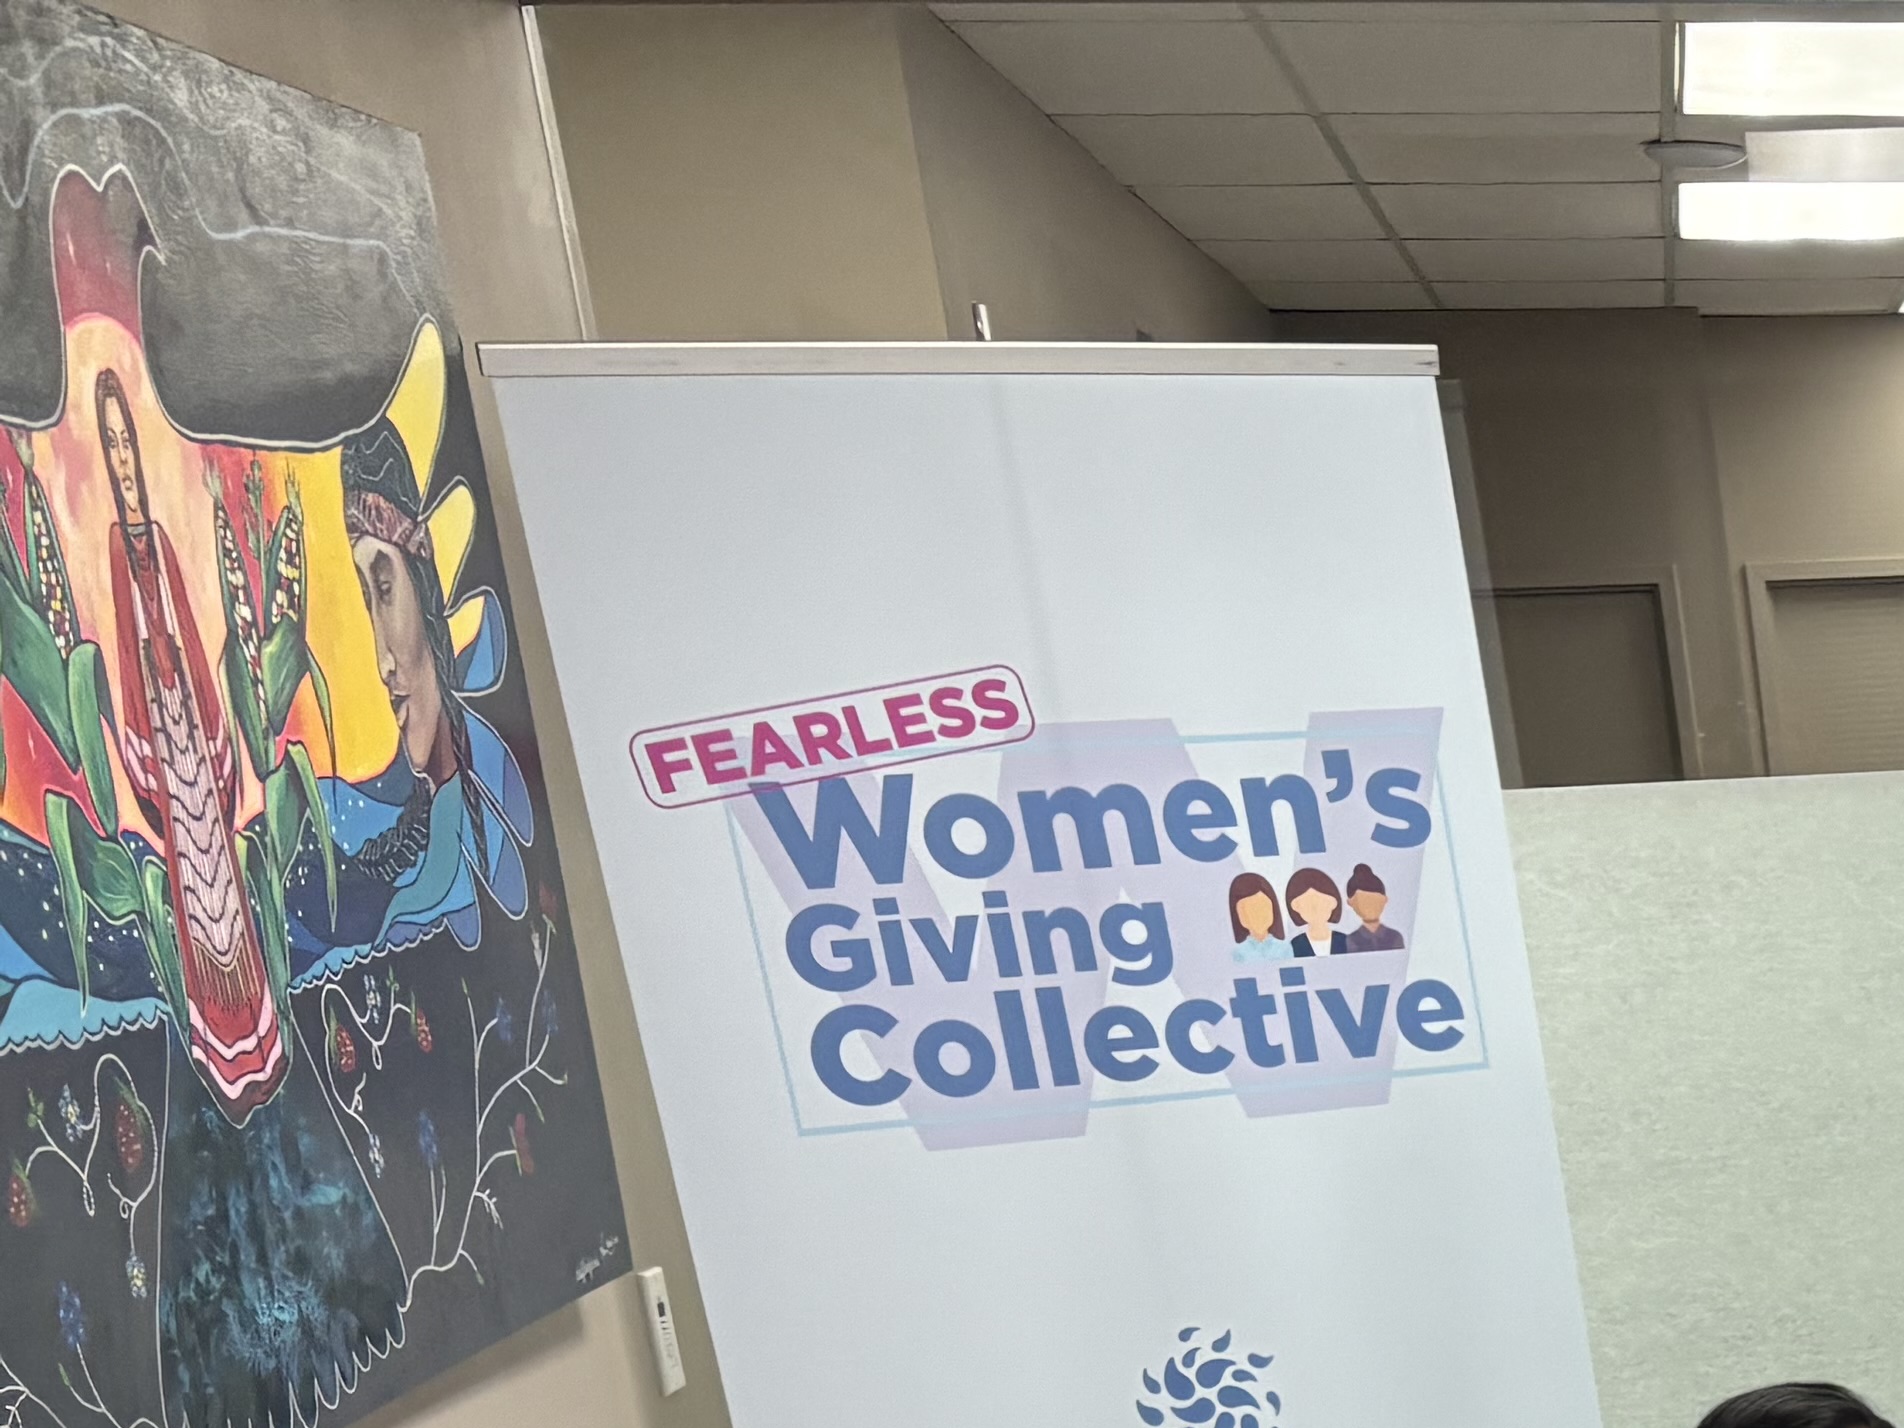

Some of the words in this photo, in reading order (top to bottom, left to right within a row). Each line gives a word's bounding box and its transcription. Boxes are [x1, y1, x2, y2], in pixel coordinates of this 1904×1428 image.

[643, 677, 1020, 797] FEARLESS
[748, 748, 1433, 891] Women's
[785, 889, 1175, 993] Giving
[809, 966, 1465, 1107] Collective
